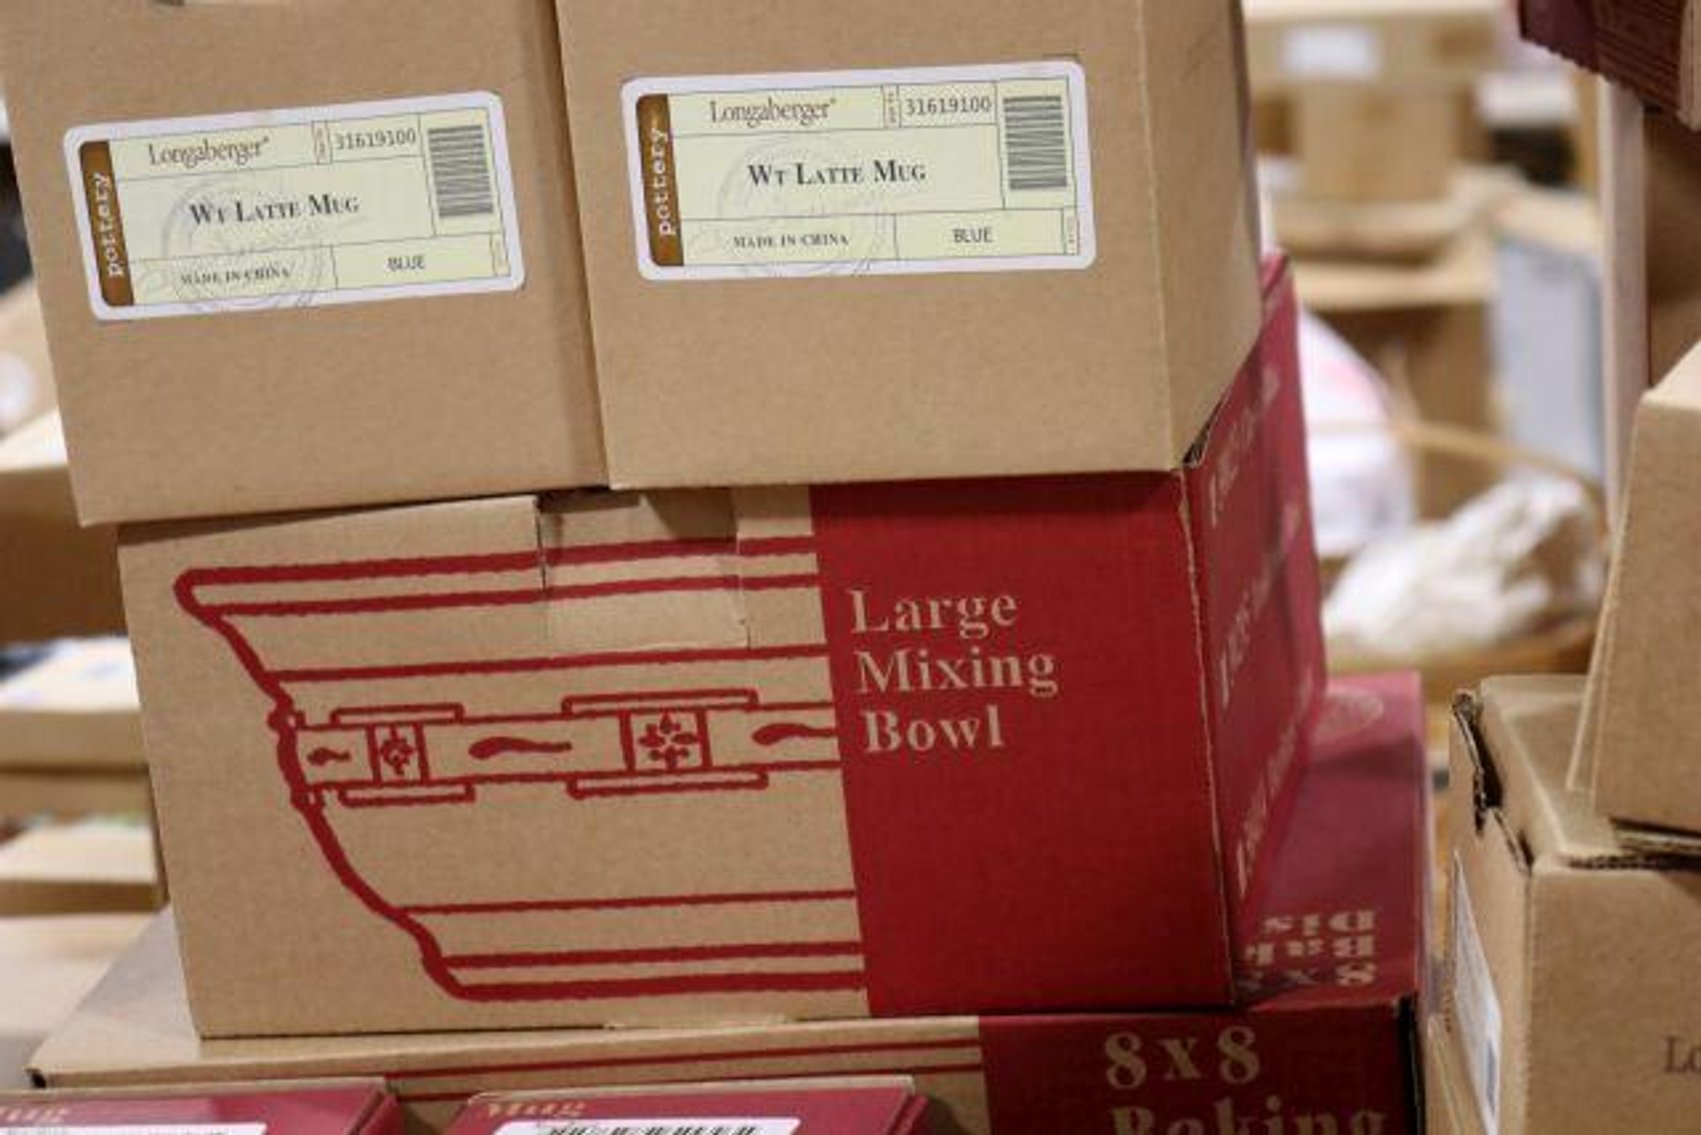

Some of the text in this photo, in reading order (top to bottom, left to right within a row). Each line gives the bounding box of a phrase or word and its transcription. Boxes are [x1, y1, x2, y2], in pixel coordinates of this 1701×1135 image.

[906, 95, 992, 117] 31619100
[335, 128, 416, 150] 31619100
[651, 127, 678, 236] pottery
[733, 231, 849, 250] MADE IN CHINA
[953, 227, 993, 244] BLUE
[847, 588, 1018, 639] Large
[853, 646, 1058, 698] Mixing
[862, 704, 1005, 754] Bowl
[1104, 1032, 1147, 1090] 8
[1217, 1025, 1260, 1084] 8
